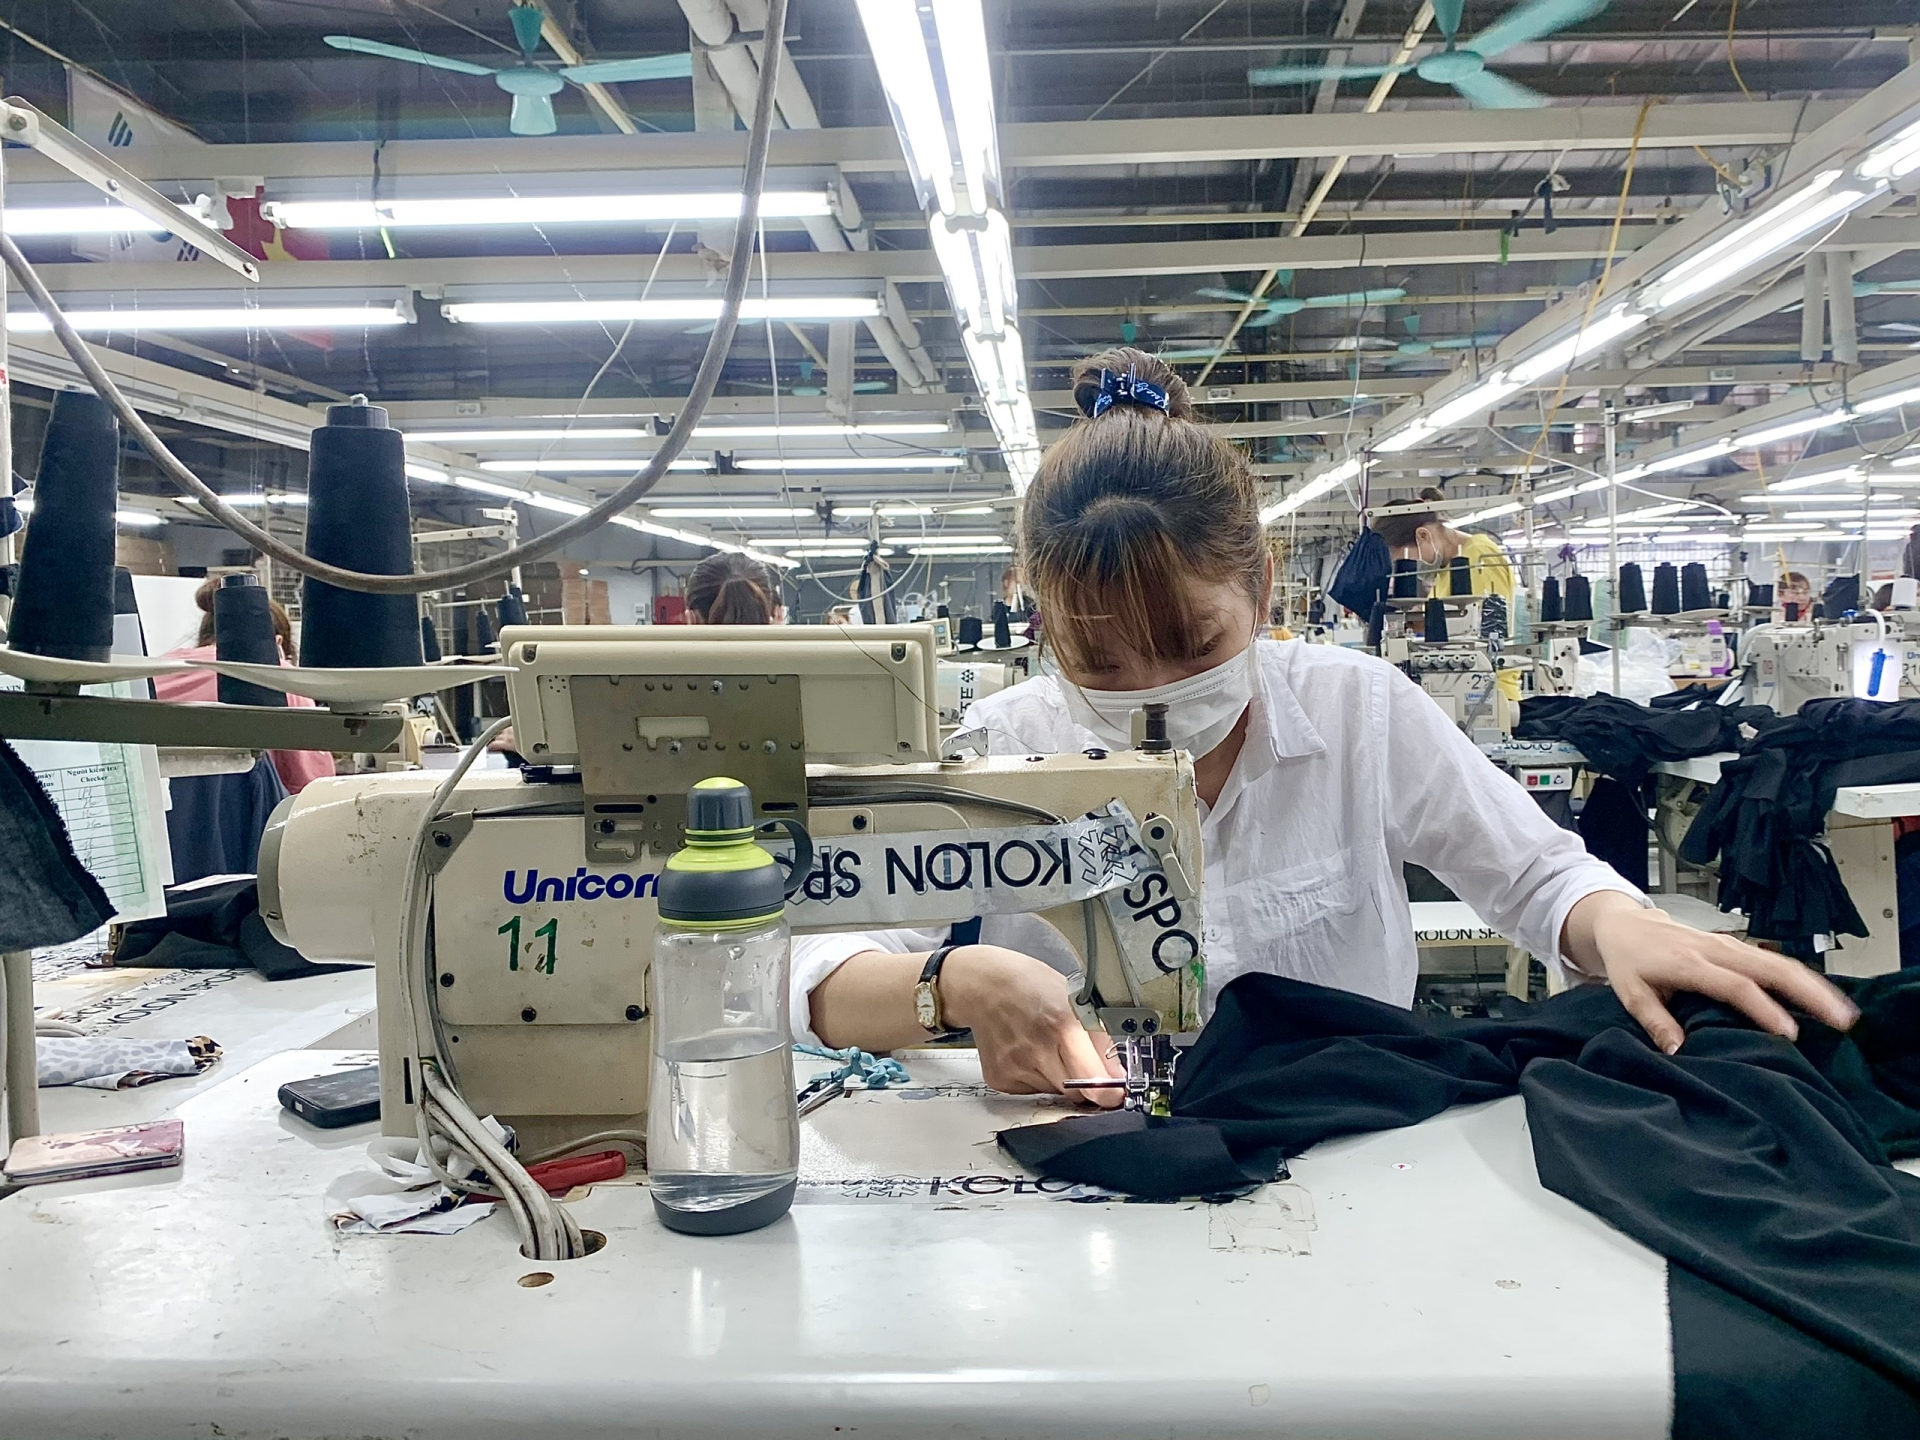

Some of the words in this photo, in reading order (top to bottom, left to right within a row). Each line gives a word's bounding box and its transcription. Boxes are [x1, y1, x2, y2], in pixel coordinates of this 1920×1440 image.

[958, 686, 974, 725] 코오
[80, 774, 108, 783] Checker
[885, 837, 1071, 895] KOLON
[497, 915, 559, 975] 11
[1122, 873, 1200, 974] SPO
[1415, 927, 1472, 941] KOLON
